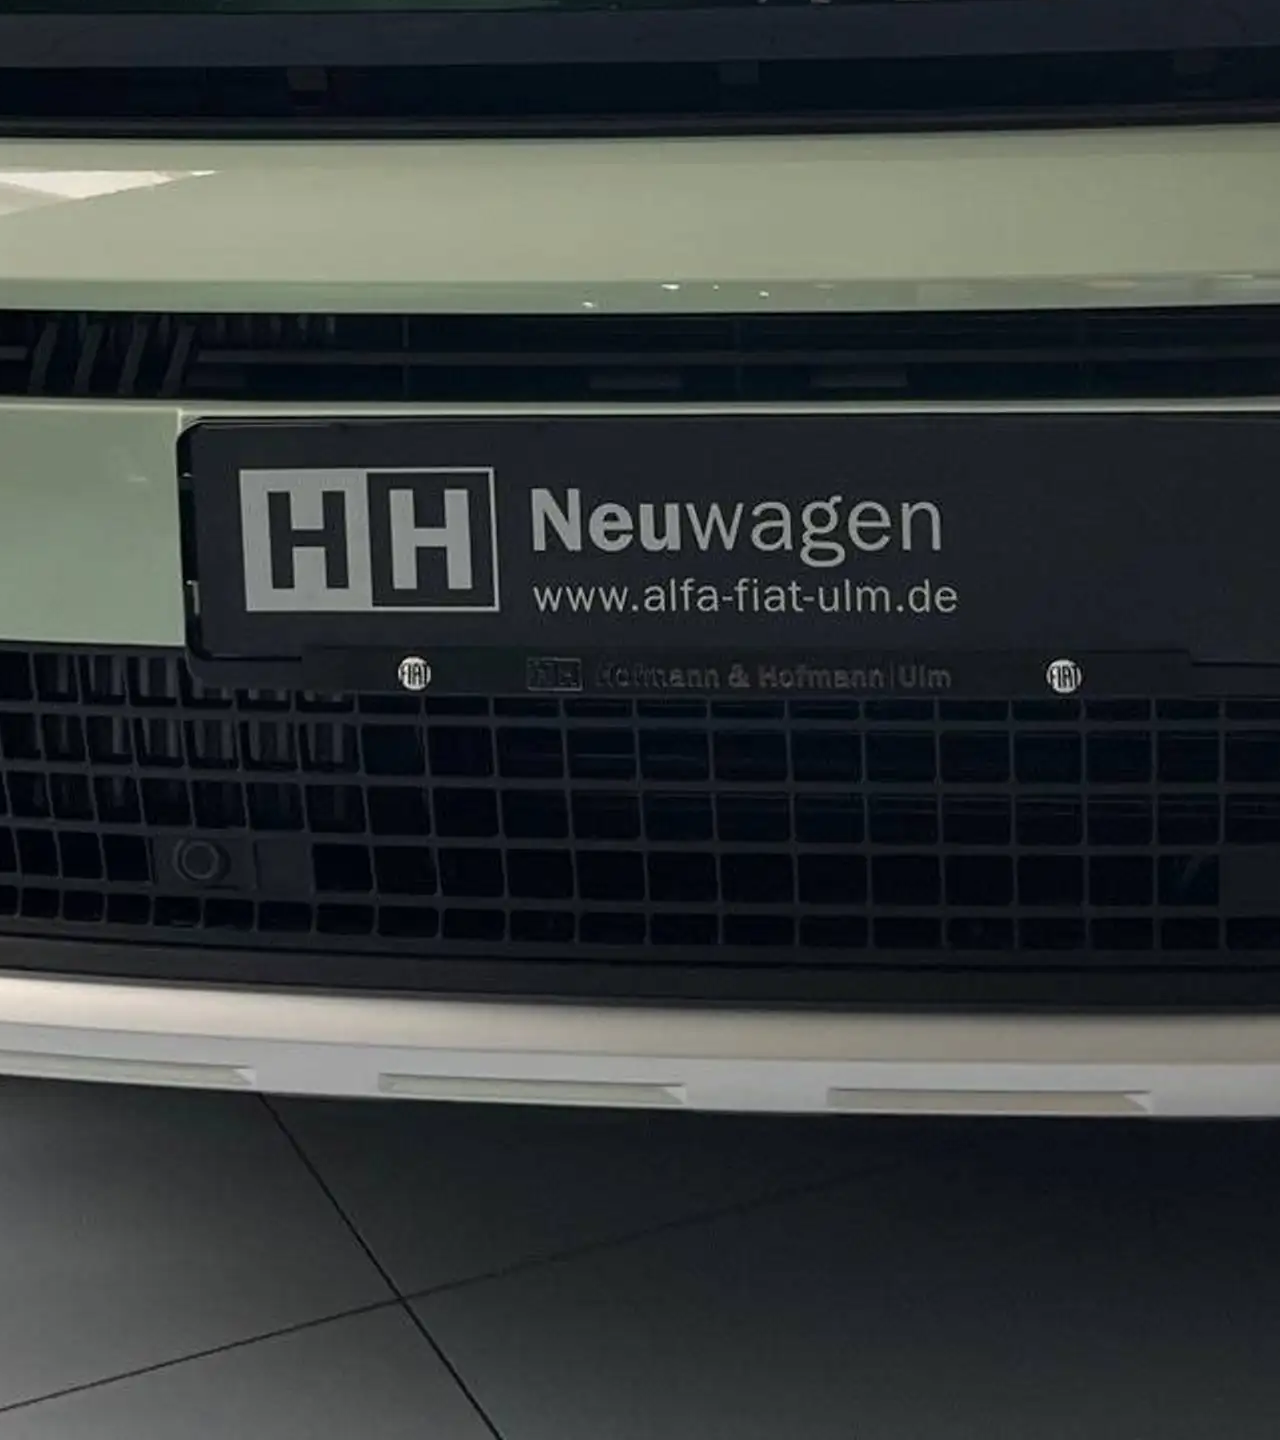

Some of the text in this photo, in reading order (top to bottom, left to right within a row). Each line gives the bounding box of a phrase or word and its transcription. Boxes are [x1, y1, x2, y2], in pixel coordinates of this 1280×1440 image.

[529, 487, 942, 568] Neuwagen
[532, 577, 959, 613] www.alfa-fiat-ulm.de
[727, 662, 752, 690] &
[758, 663, 885, 691] Hofmann
